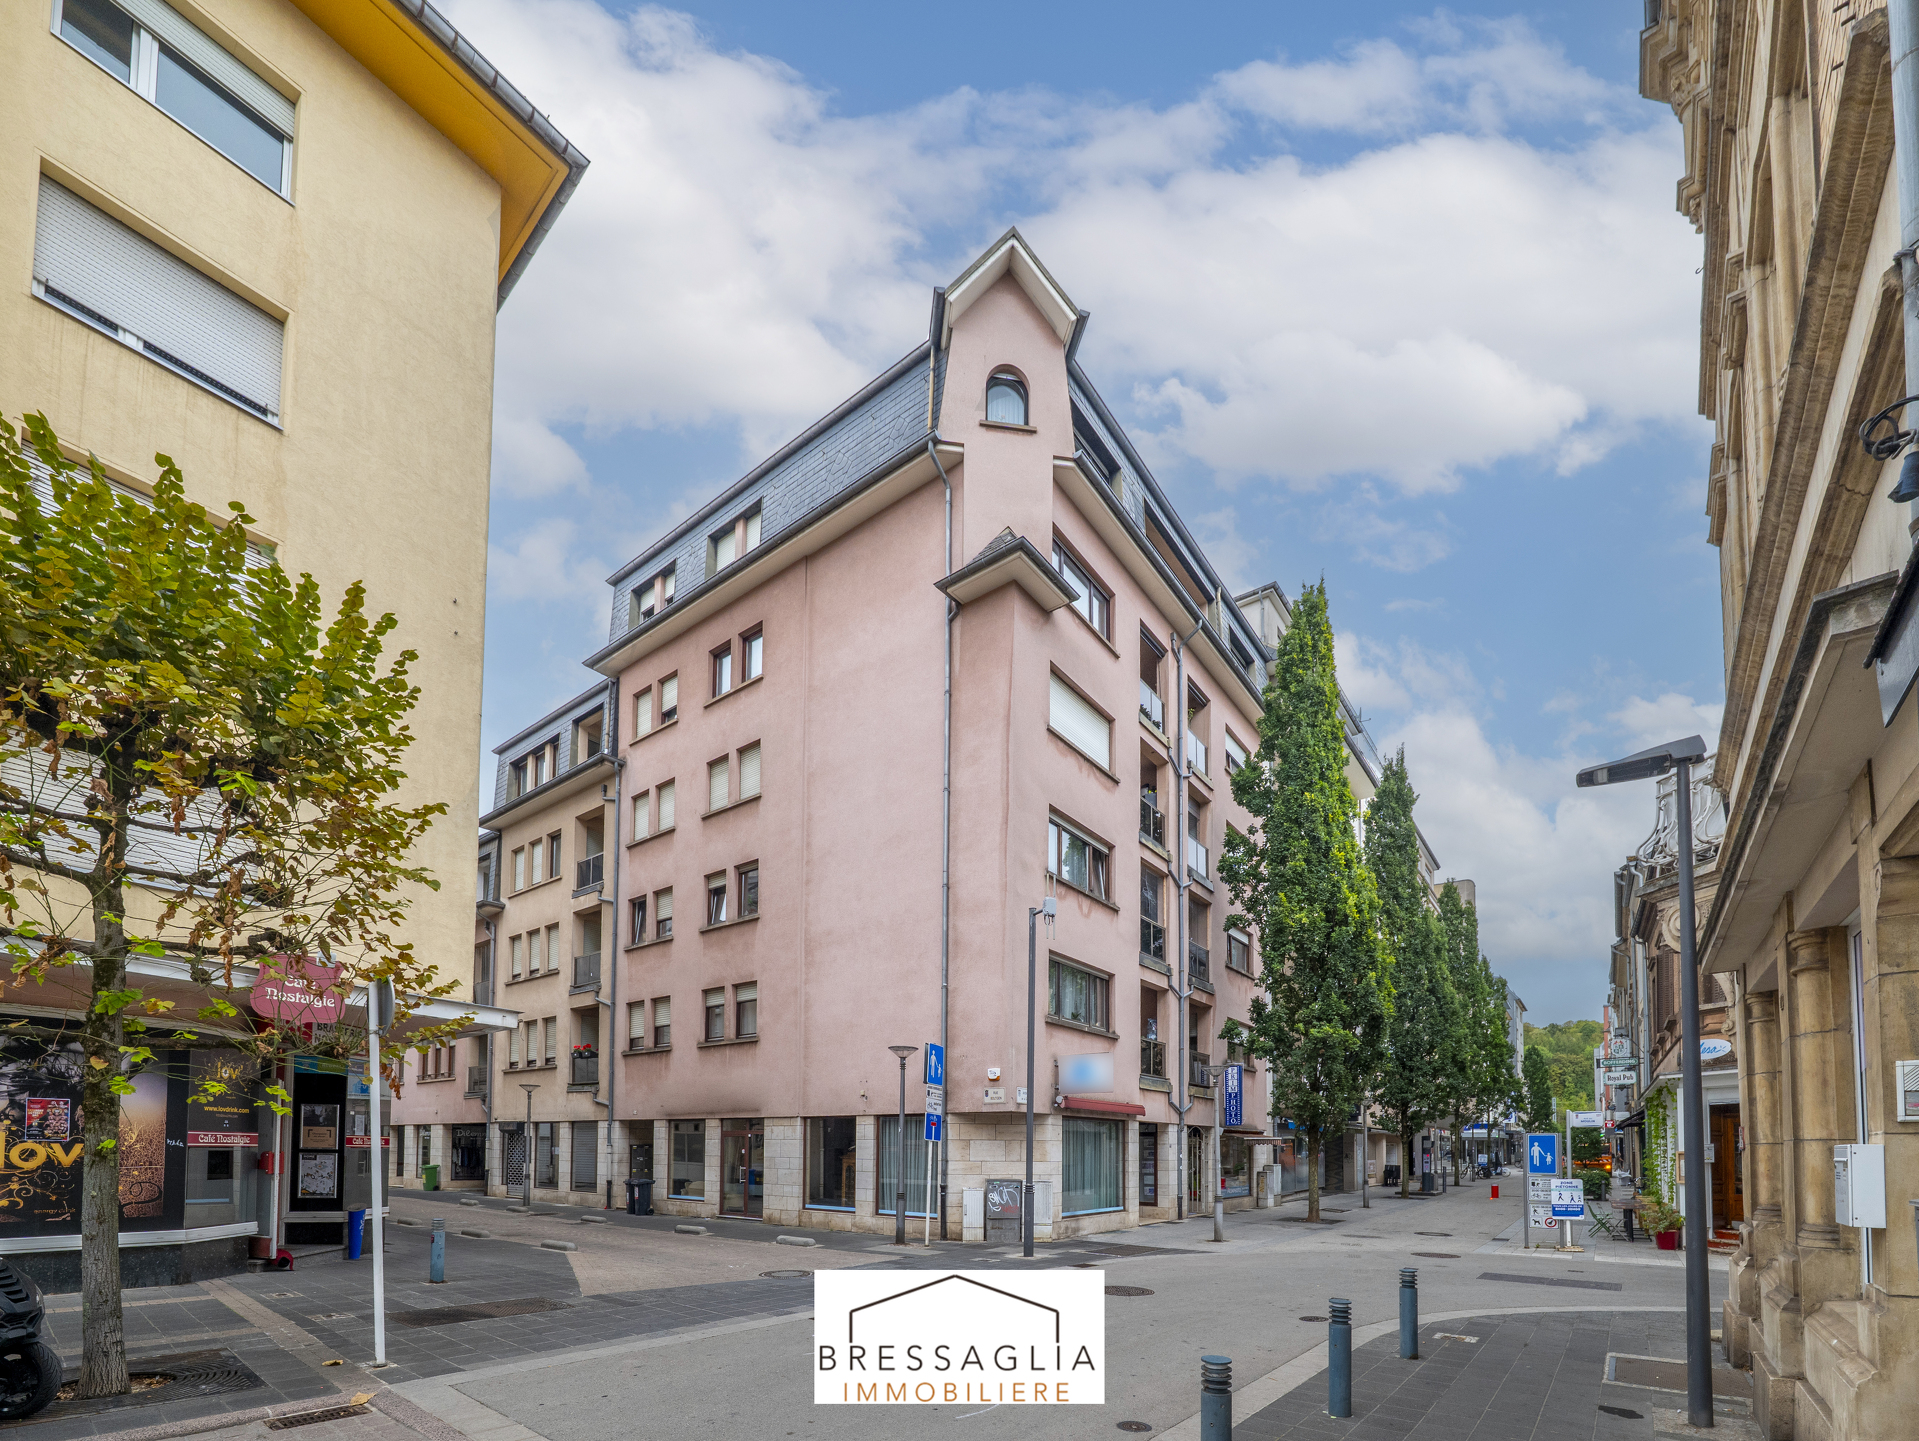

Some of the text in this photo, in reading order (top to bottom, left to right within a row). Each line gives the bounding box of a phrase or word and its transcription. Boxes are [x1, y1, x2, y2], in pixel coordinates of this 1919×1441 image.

[265, 987, 335, 1008] Nostalgie
[317, 1023, 362, 1036] BRAERE
[1700, 1041, 1720, 1054] esa
[1607, 1073, 1634, 1082] Royal Pub
[198, 1134, 251, 1145] Café Nostalgie
